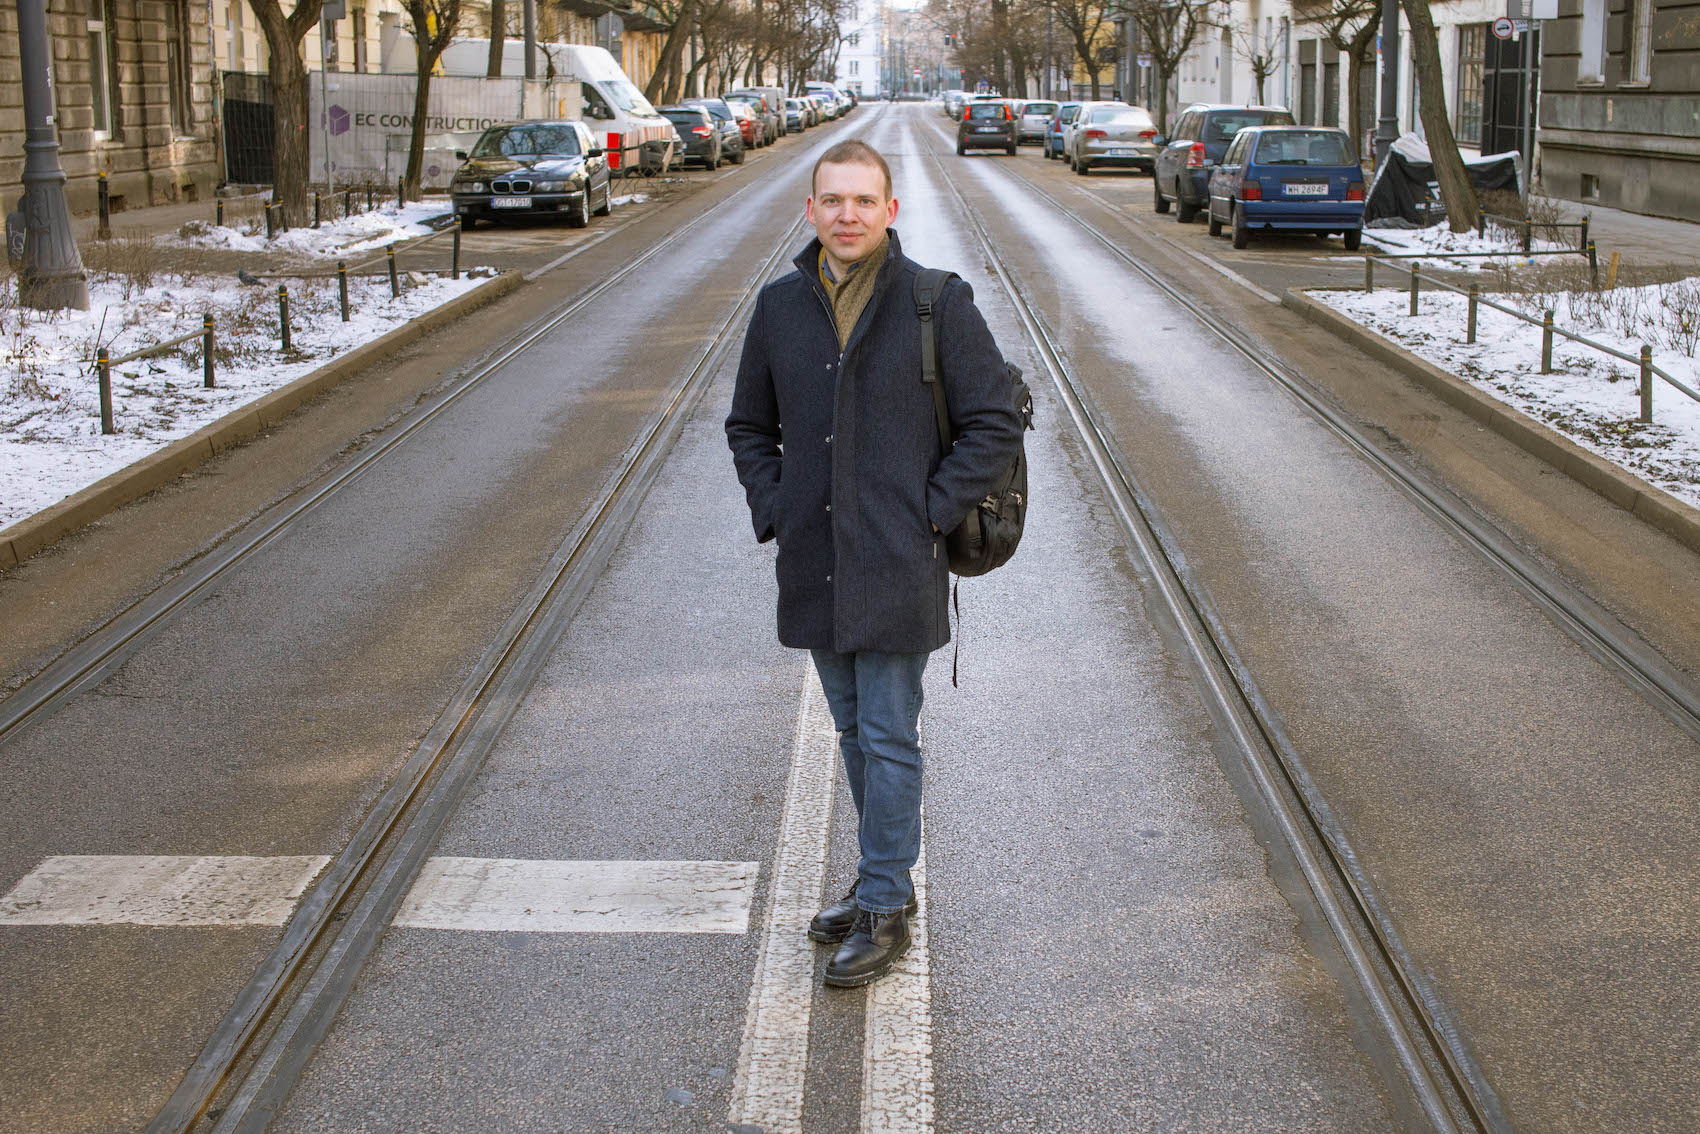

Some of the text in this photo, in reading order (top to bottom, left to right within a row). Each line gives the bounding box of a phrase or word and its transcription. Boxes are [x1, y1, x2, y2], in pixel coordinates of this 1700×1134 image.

[355, 114, 504, 130] EC CONTRUCTIO
[1288, 185, 1299, 194] WH
